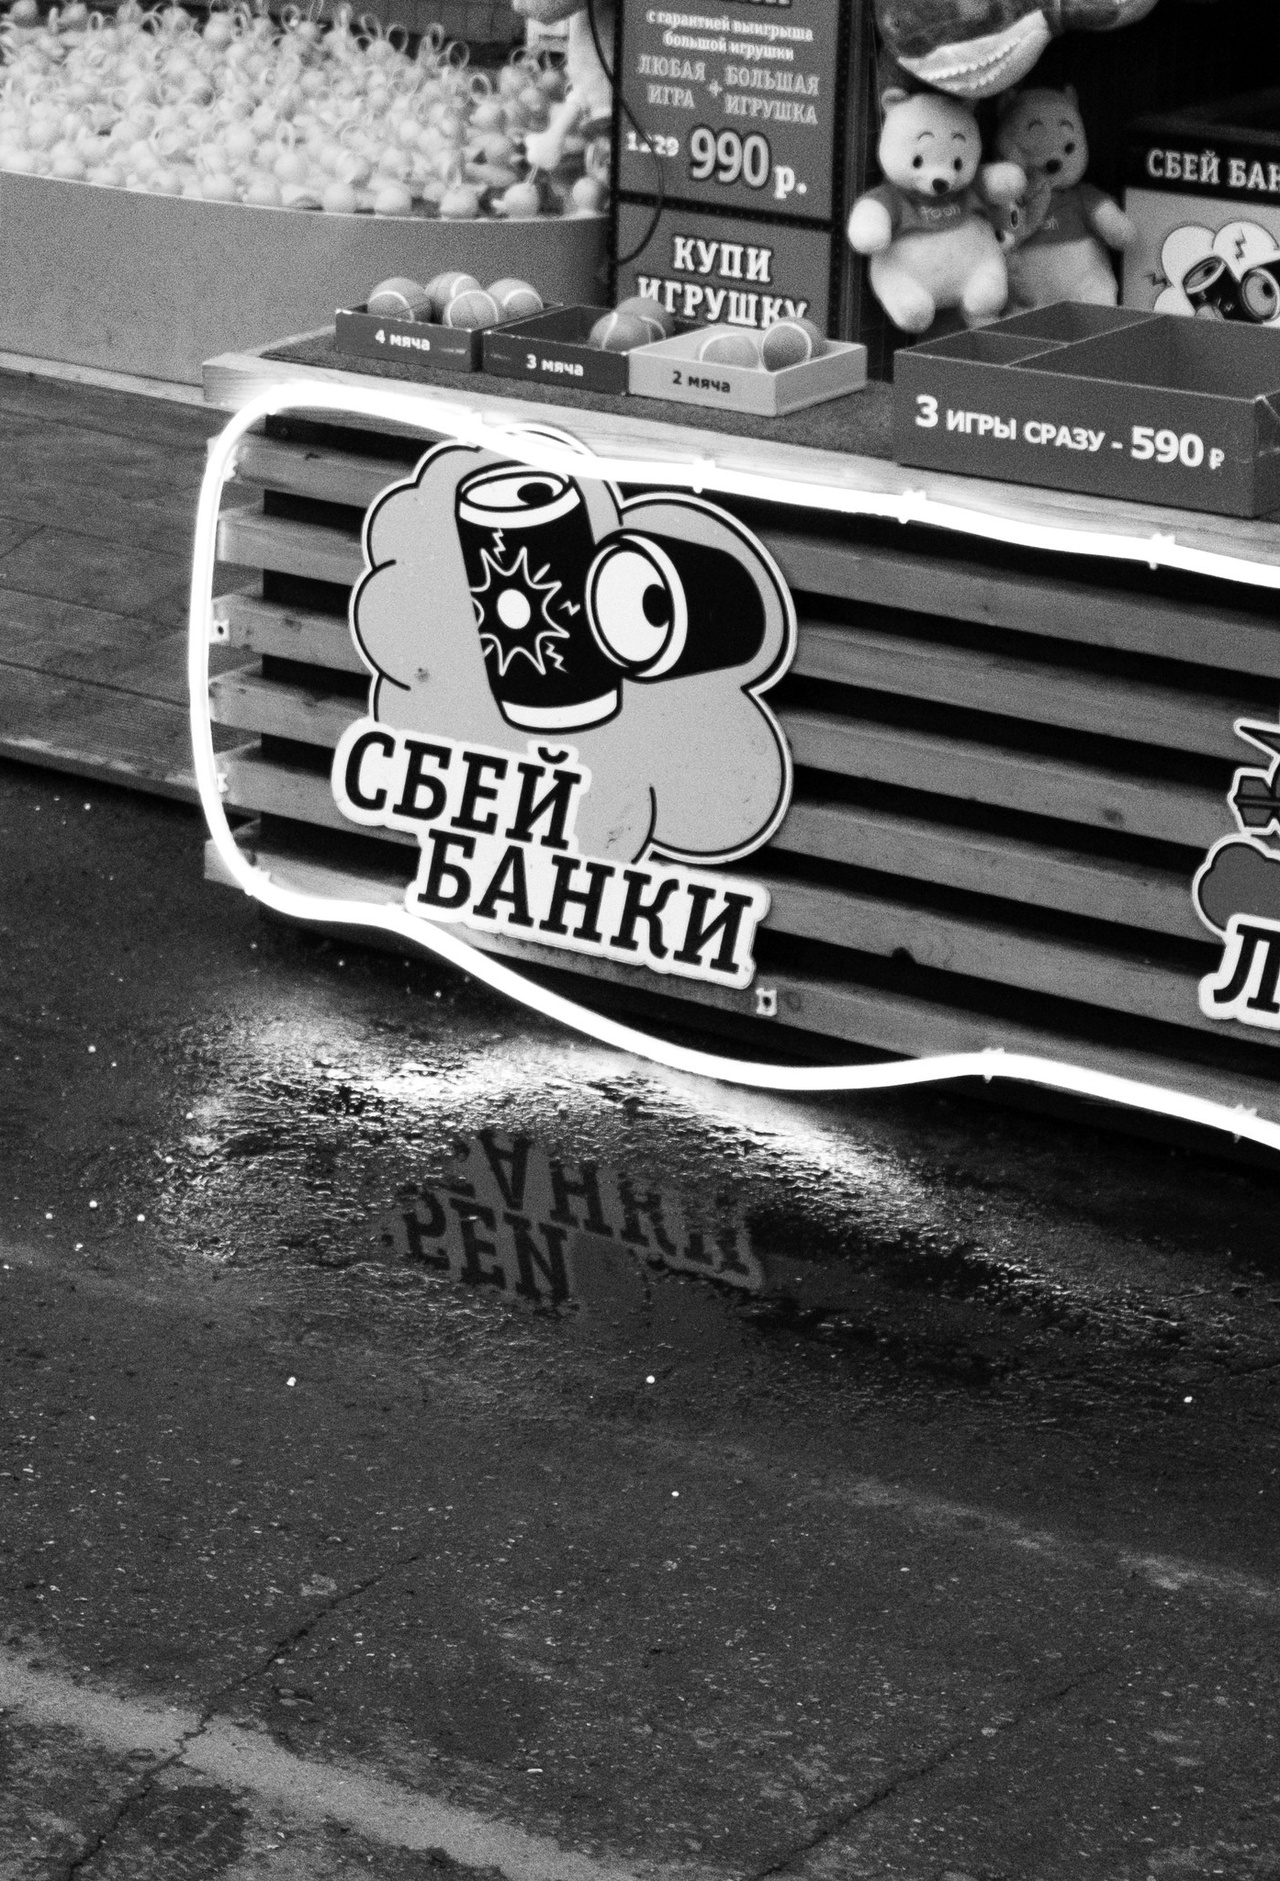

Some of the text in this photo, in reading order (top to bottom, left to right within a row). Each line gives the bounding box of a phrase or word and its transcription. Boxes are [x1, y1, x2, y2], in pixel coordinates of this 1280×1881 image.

[657, 10, 731, 32] гарантией
[731, 20, 814, 42] выигрыша
[663, 29, 795, 61] большой игрушки
[637, 53, 706, 81] ЛЮБАЯ
[725, 65, 820, 96] БОЛЬШАЯ
[647, 83, 819, 125] ИГРА ИГРУШКА
[690, 127, 770, 188] 990
[1147, 147, 1221, 185] СБЕЙ
[673, 235, 772, 283] КУПИ
[375, 329, 431, 352] 4 мяча
[526, 353, 584, 377] 3 мяча
[672, 370, 731, 393] 2 мяча
[915, 394, 939, 428] 3
[946, 409, 1017, 440] ИГРЫ
[1024, 421, 1106, 452] СРАЗУ
[1131, 425, 1204, 469] 590
[344, 729, 582, 851] СБЕЙ
[417, 827, 755, 975] БАНКИ
